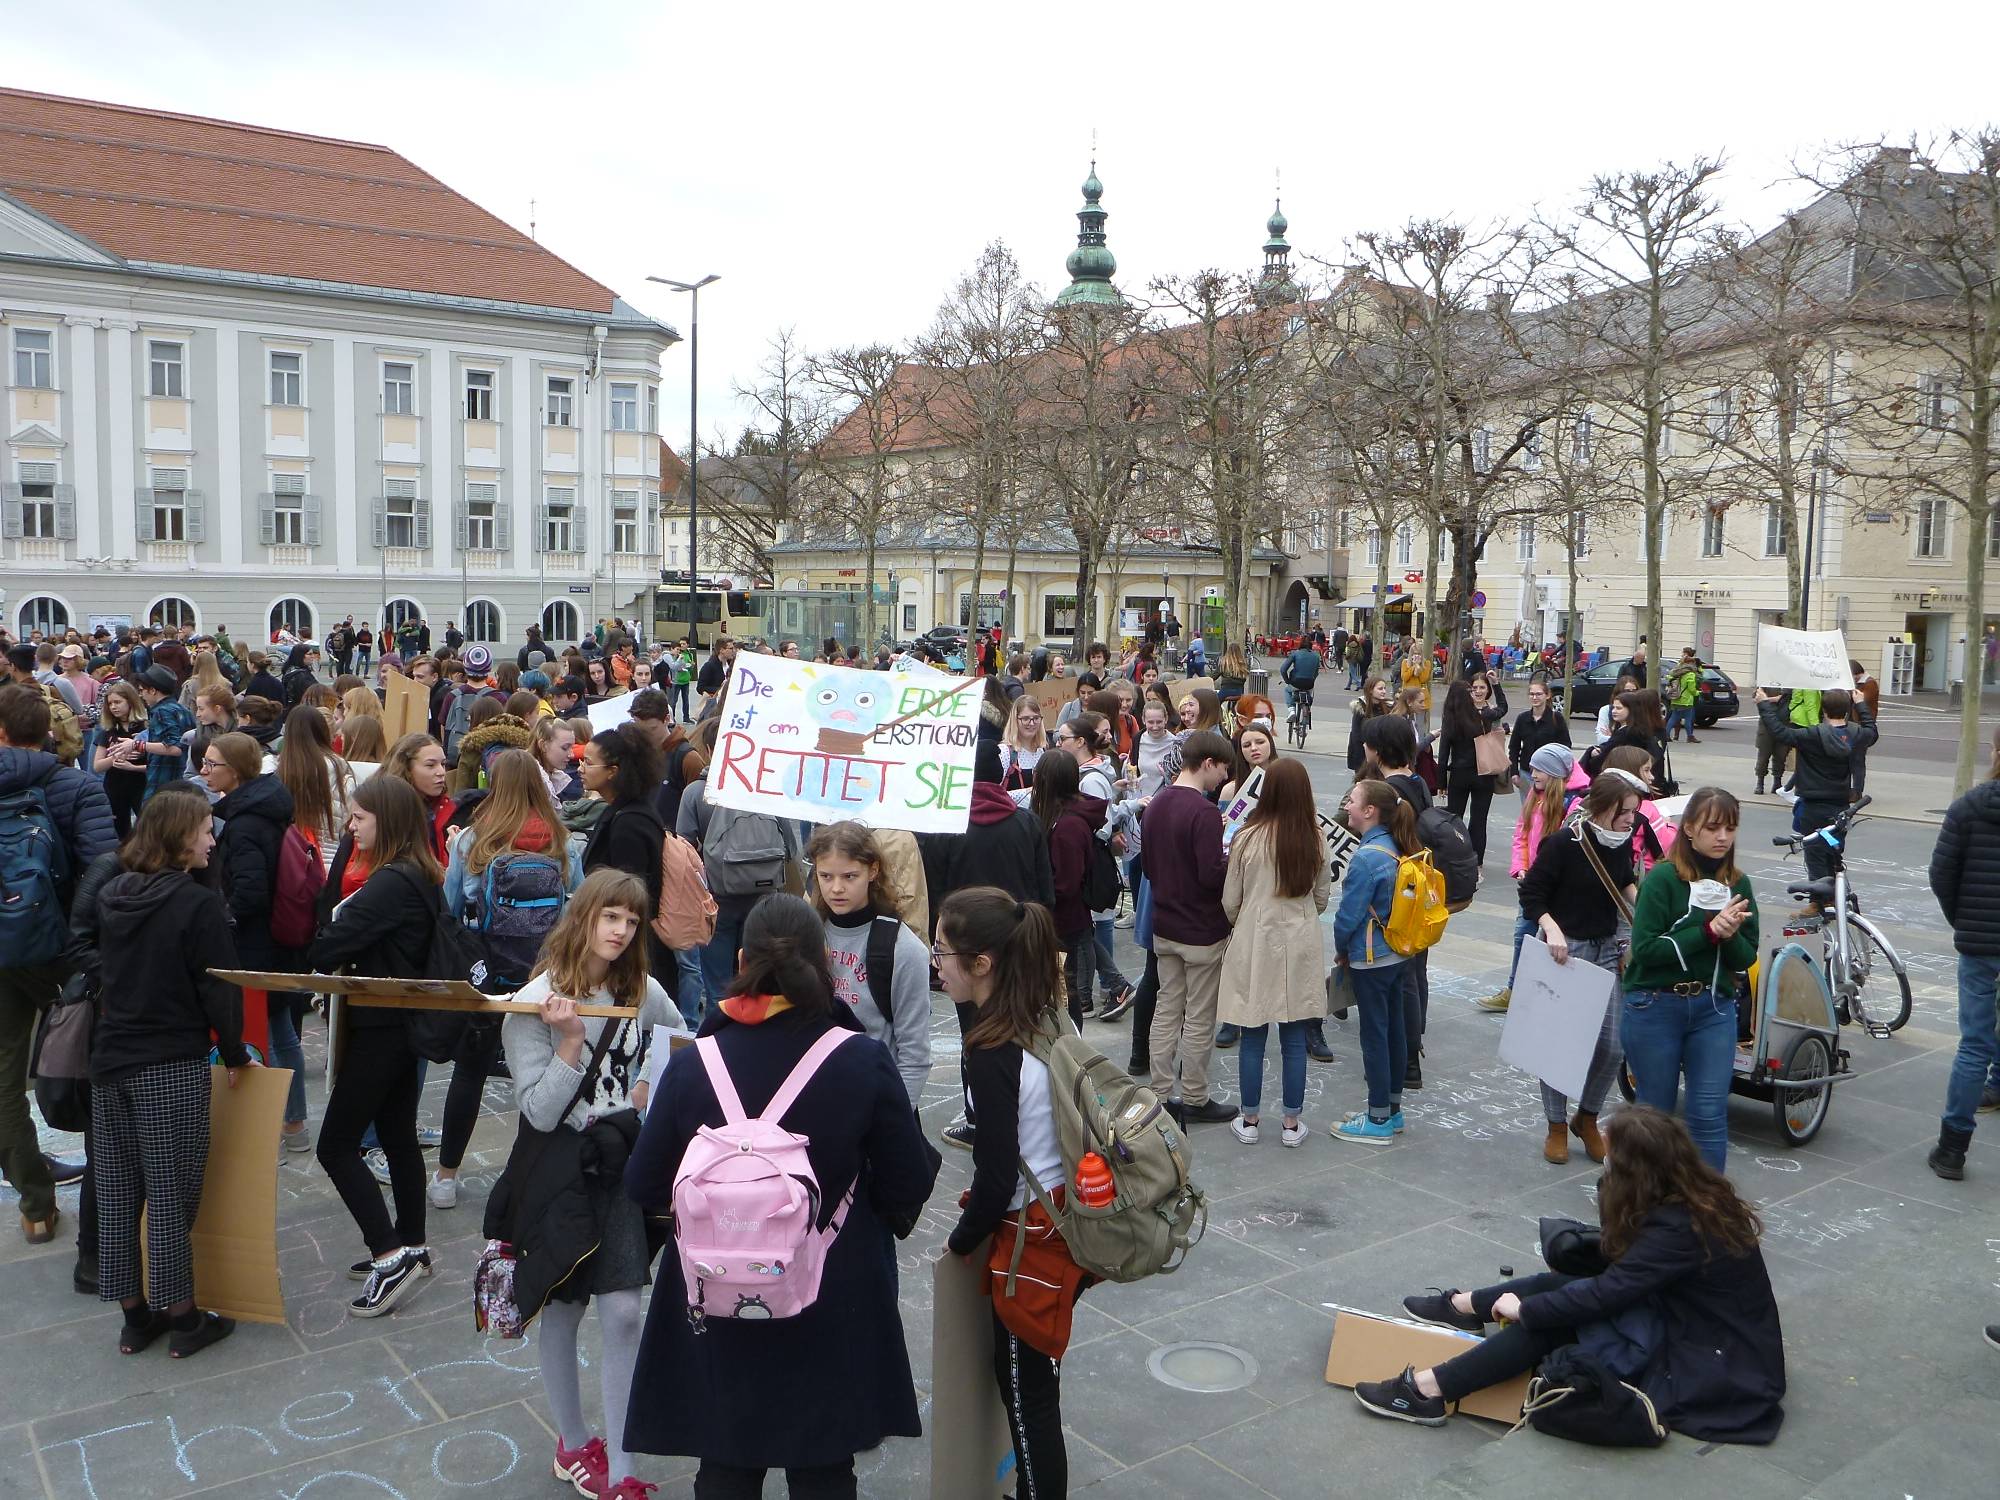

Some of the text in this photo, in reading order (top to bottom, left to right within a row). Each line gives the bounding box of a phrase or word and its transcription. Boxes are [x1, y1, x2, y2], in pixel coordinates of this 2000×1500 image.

[735, 667, 977, 718] Die ERDE
[730, 703, 979, 747] ist am ERSTICKEN
[717, 731, 973, 810] RETTET SIE
[1316, 813, 1361, 864] THE
